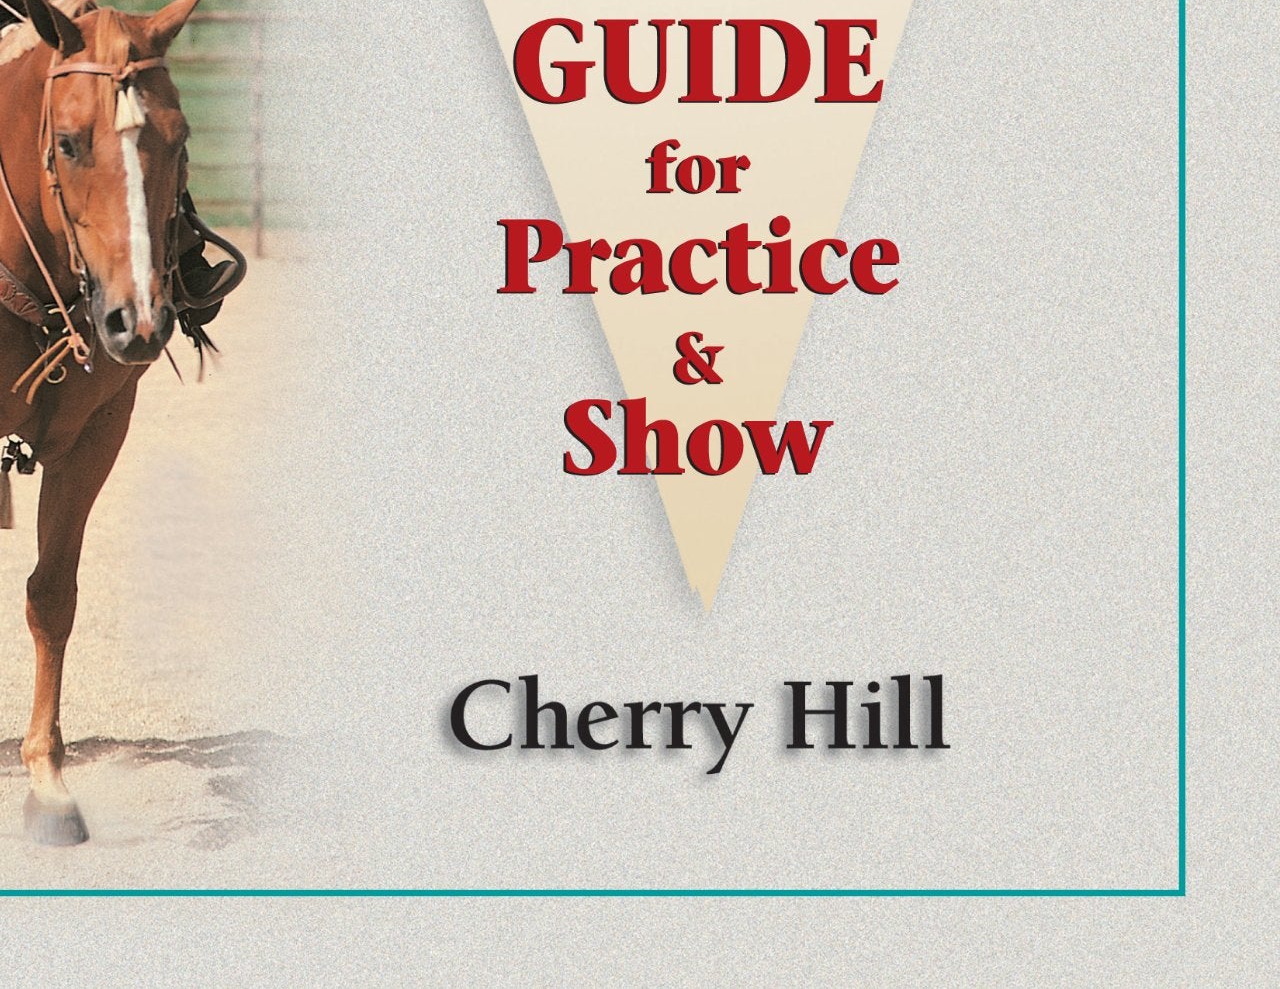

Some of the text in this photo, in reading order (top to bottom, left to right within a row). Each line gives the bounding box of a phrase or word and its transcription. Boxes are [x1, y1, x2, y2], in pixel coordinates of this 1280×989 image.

[514, 17, 886, 105] GUIDE
[646, 139, 752, 195] for
[498, 216, 900, 296] Practice
[673, 332, 724, 385] &
[563, 398, 835, 477] Show
[449, 673, 951, 776] Cherry Hill
